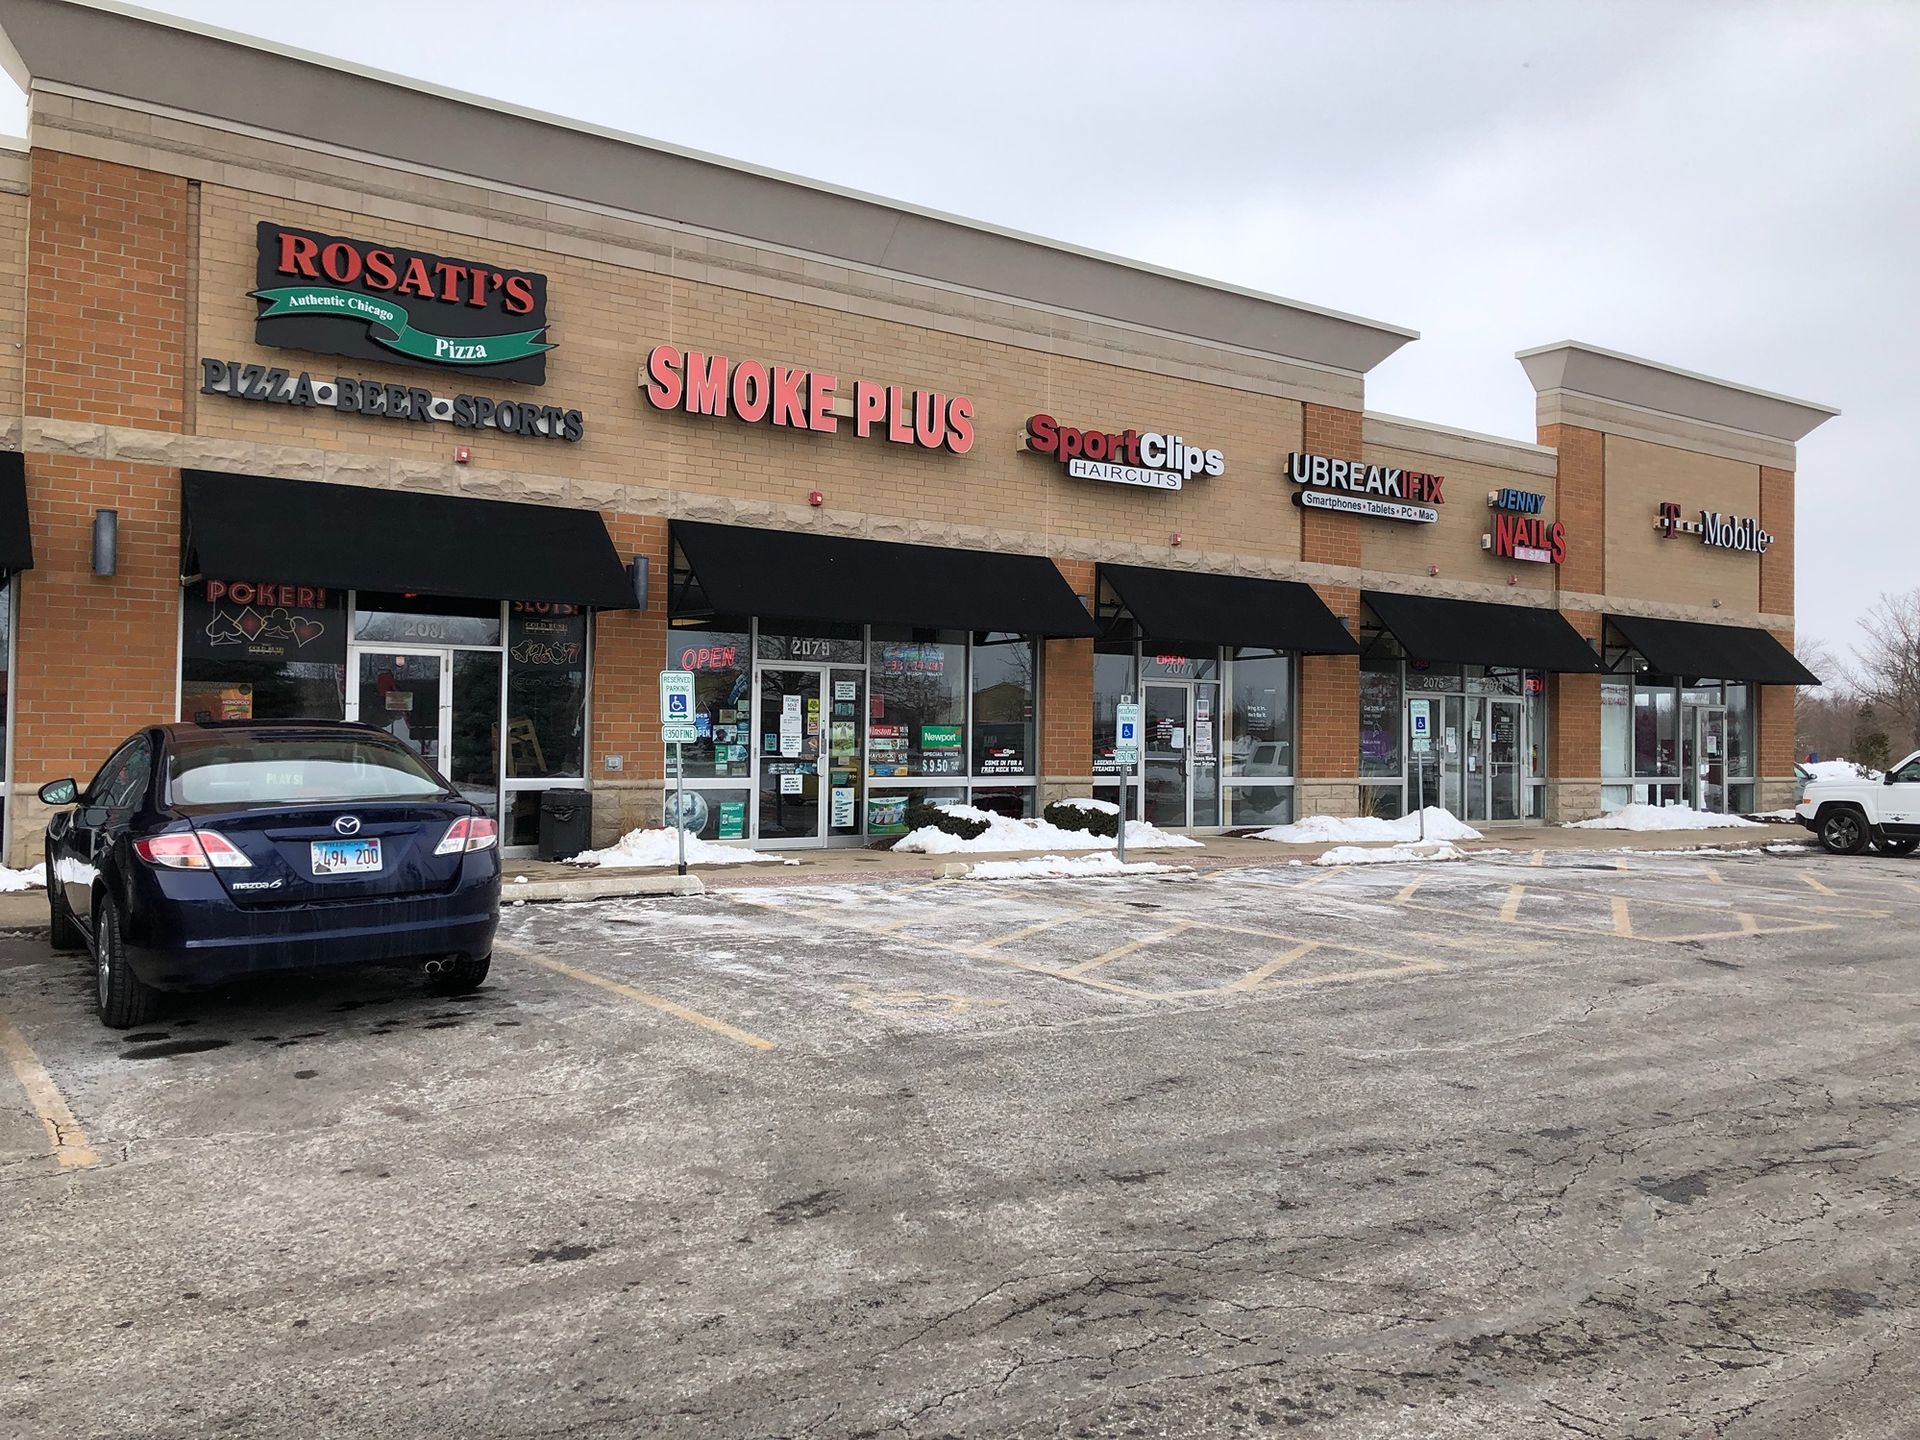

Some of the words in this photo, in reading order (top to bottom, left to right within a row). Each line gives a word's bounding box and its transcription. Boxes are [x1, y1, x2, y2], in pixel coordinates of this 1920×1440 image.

[278, 232, 535, 314] ROSATI'S
[288, 295, 345, 309] Authentic
[347, 298, 395, 321] Chicago
[434, 338, 488, 360] Pizza
[201, 358, 318, 408] PIZZA
[335, 377, 433, 424] BEER
[452, 394, 584, 442] SPORTS
[646, 344, 838, 433] SMOKE
[853, 380, 975, 454] PLUS
[1074, 461, 1178, 488] HAIRCUTS
[1306, 493, 1362, 511] Smartphones
[1367, 502, 1395, 516] Tablets
[1401, 507, 1413, 518] PC
[1418, 509, 1435, 521] Mac
[1498, 488, 1546, 514] JENNY
[1495, 512, 1567, 565] NAILS
[1529, 549, 1546, 560] SPA
[207, 580, 328, 608] POKER!
[403, 621, 445, 639] 2081
[792, 639, 830, 656] 2079
[681, 647, 736, 671] OPEN
[1156, 655, 1185, 665] OPEN
[1166, 663, 1193, 674] 2077
[663, 676, 691, 684] RESERVED
[1423, 677, 1445, 689] 2075
[680, 729, 694, 739] FINE
[924, 732, 956, 742] Newport
[323, 850, 347, 867] 494
[355, 848, 379, 865] 200
